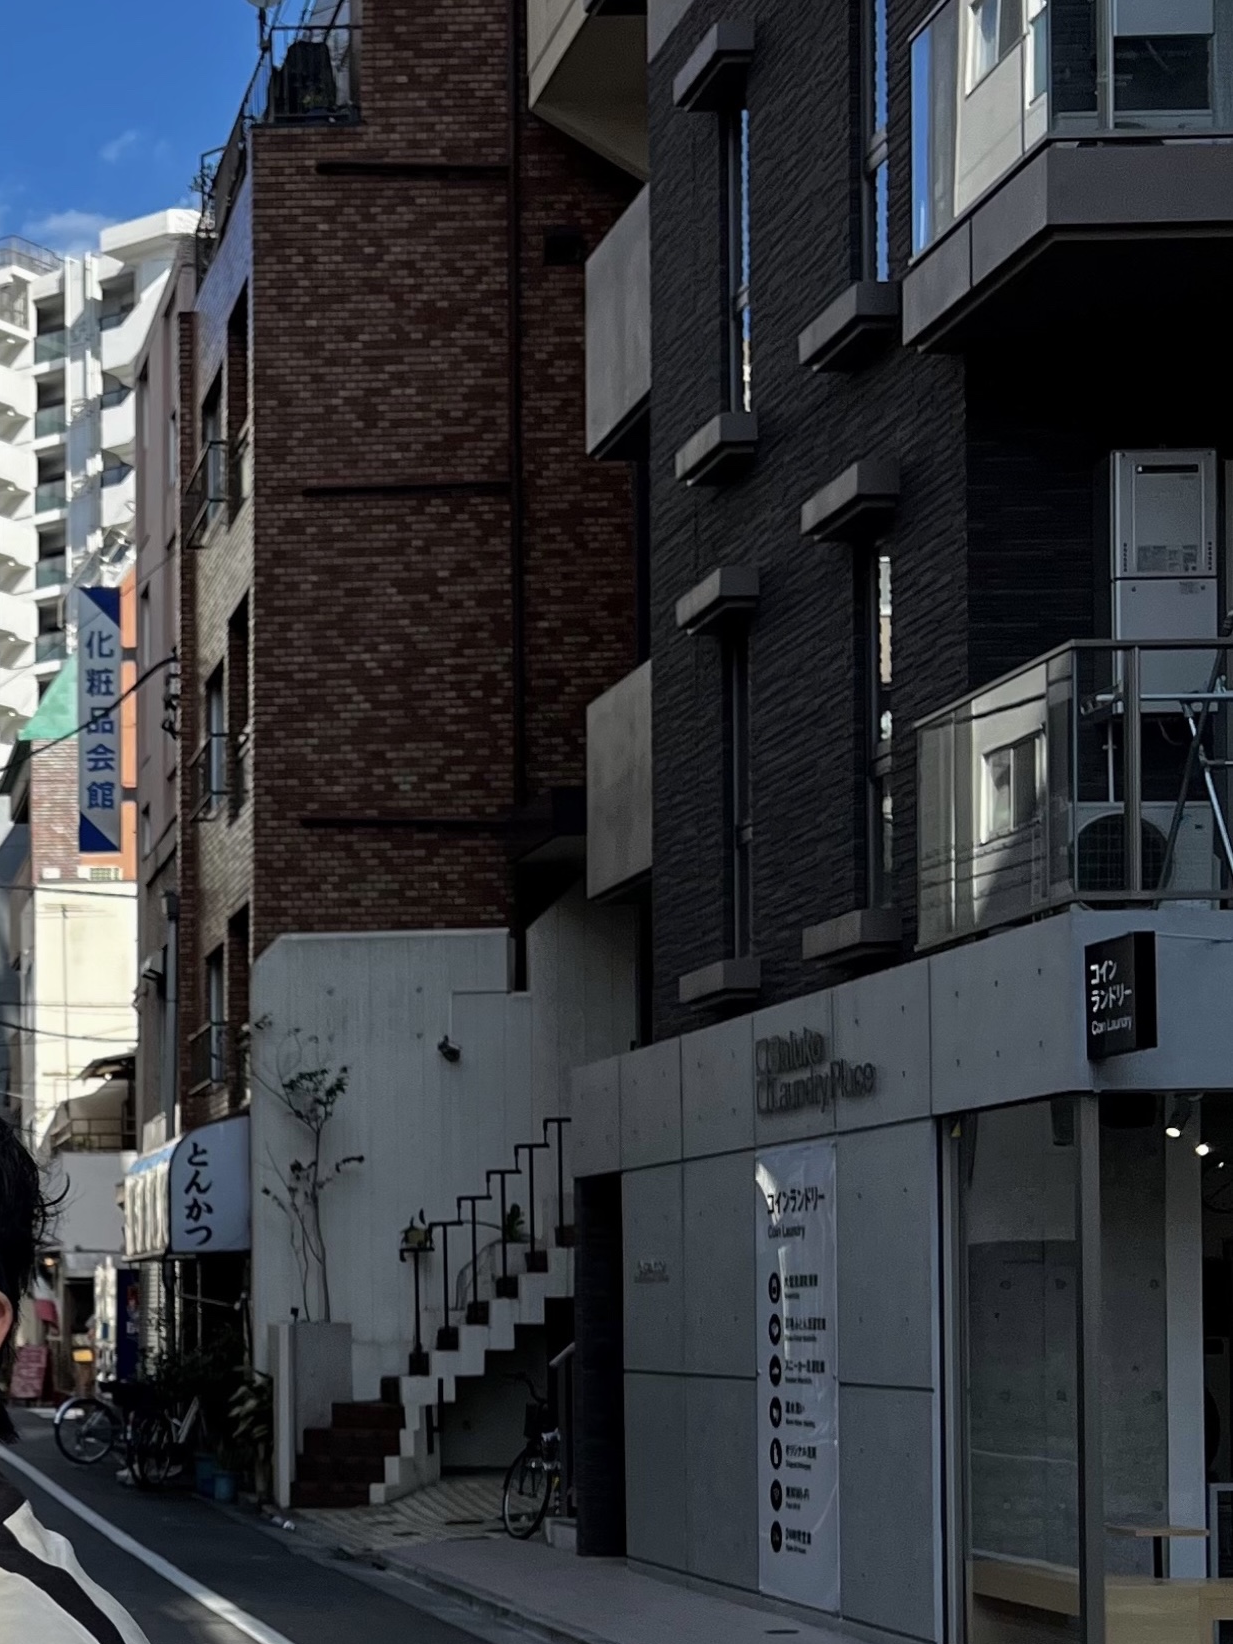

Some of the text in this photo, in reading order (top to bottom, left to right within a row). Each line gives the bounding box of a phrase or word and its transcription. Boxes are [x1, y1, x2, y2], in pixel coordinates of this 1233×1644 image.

[85, 630, 116, 812] 化粧品会館
[1089, 959, 1117, 986] コイン
[1090, 982, 1133, 1014] ランドリー
[183, 1142, 213, 1247] とんかつ
[767, 1187, 825, 1214] コインランドリー
